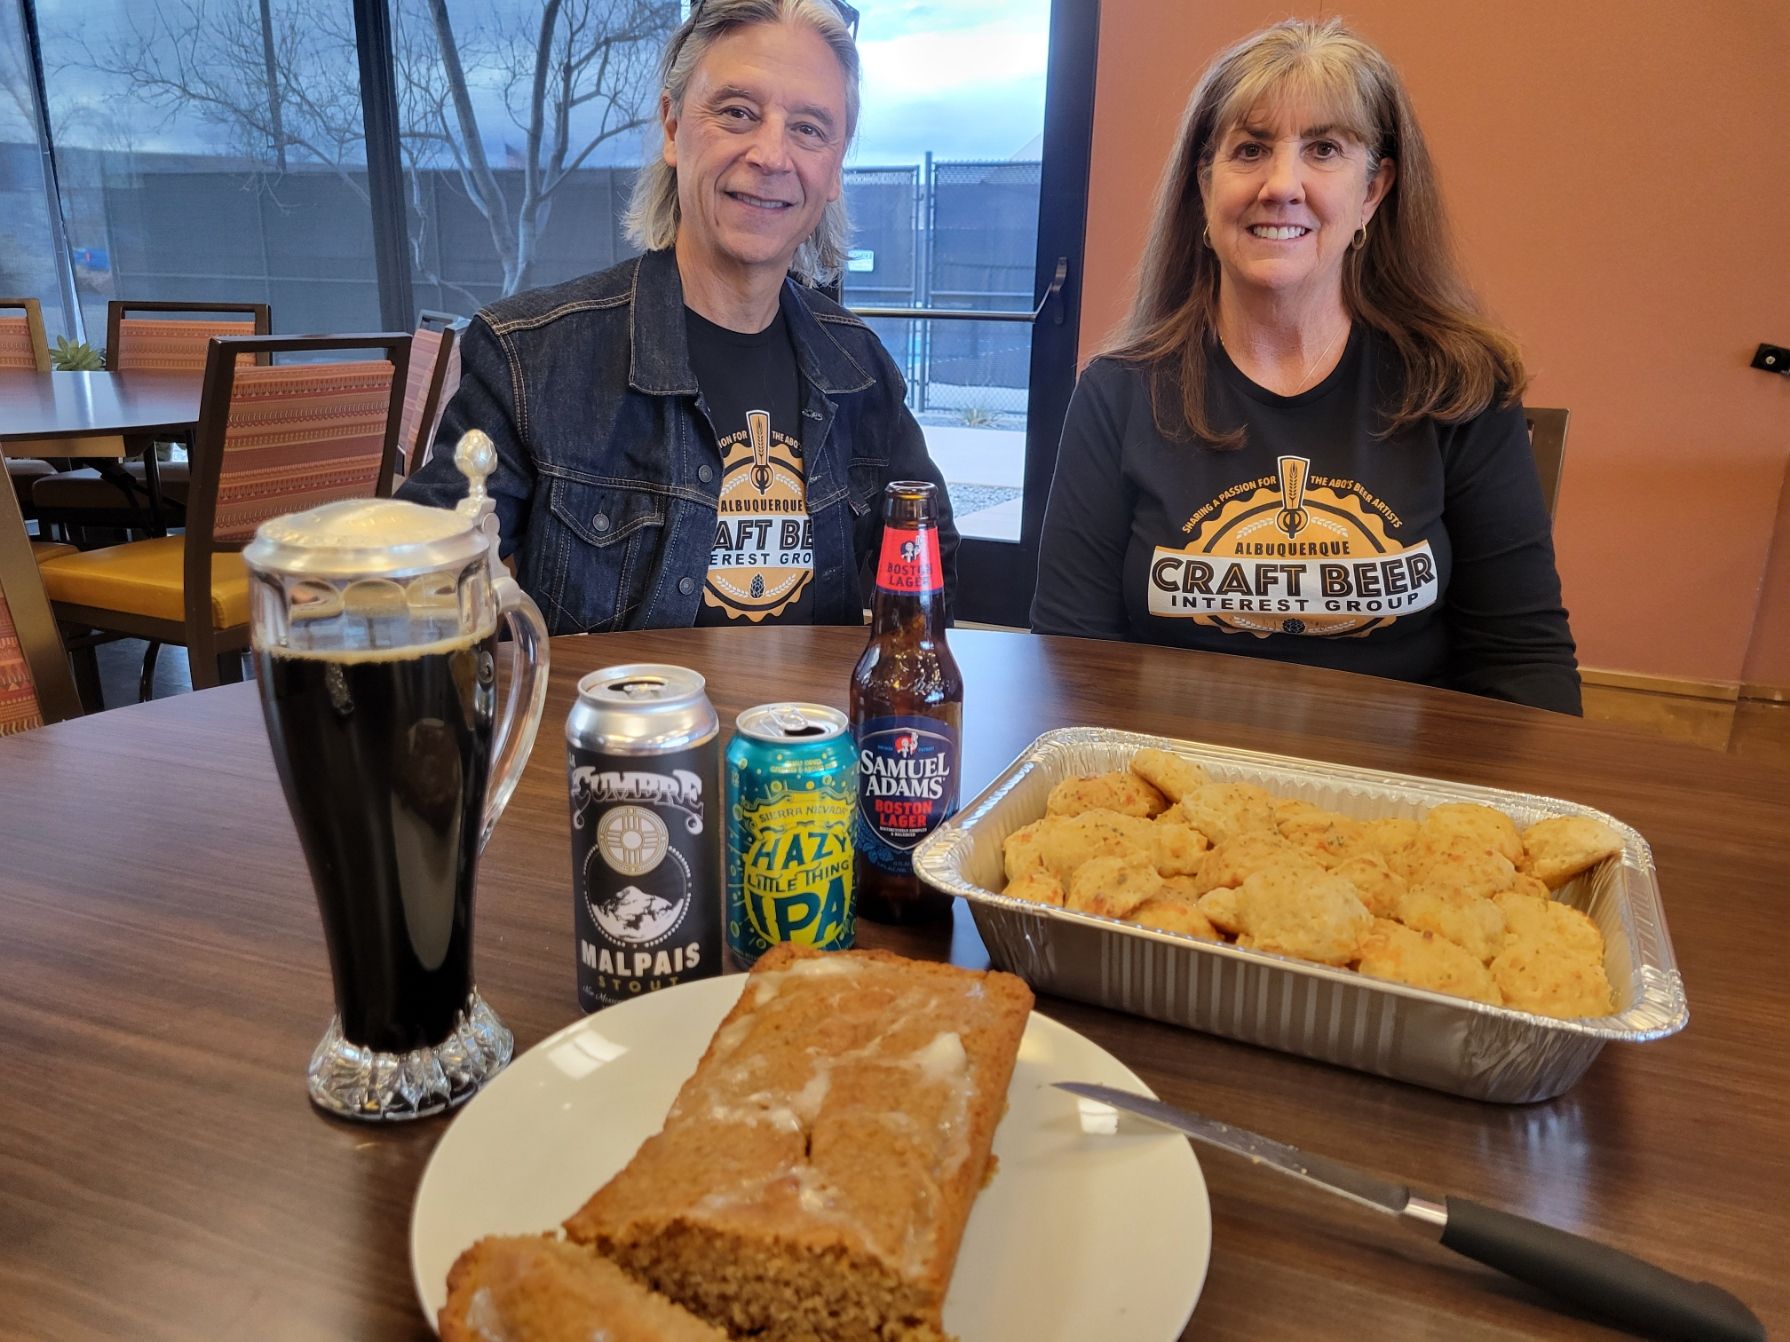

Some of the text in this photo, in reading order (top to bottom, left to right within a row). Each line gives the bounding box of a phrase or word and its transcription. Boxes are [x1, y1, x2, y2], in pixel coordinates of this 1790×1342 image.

[732, 430, 748, 444] FOR
[771, 430, 785, 442] THE
[720, 498, 803, 513] ALBUQUERQUE
[1182, 501, 1214, 534] SHARING
[1211, 499, 1221, 508] A
[1218, 480, 1257, 502] PASSION
[1258, 475, 1277, 488] FOR
[1310, 475, 1329, 486] THE
[1353, 482, 1374, 503] BEER
[1371, 498, 1403, 528] ARTISTS
[711, 519, 814, 551] AFT BE
[709, 552, 812, 566] EREST GRO
[1235, 541, 1350, 557] ALBUQUERQUE
[887, 562, 933, 576] BOSTON
[1151, 552, 1436, 599] CRAFT BEER
[1171, 592, 1419, 612] INTEREST GROUP
[861, 749, 950, 779] SAMUEL
[865, 775, 944, 800] ADAMS
[759, 806, 802, 823] SIERRA
[875, 799, 933, 815] BOSTON
[879, 814, 927, 828] LAGER
[751, 831, 848, 871] HAZY
[747, 872, 798, 893] LITTLE
[797, 860, 850, 887] THING
[749, 875, 846, 944] IPA
[580, 939, 701, 978] MALPAIS
[598, 975, 679, 993] STOUT
